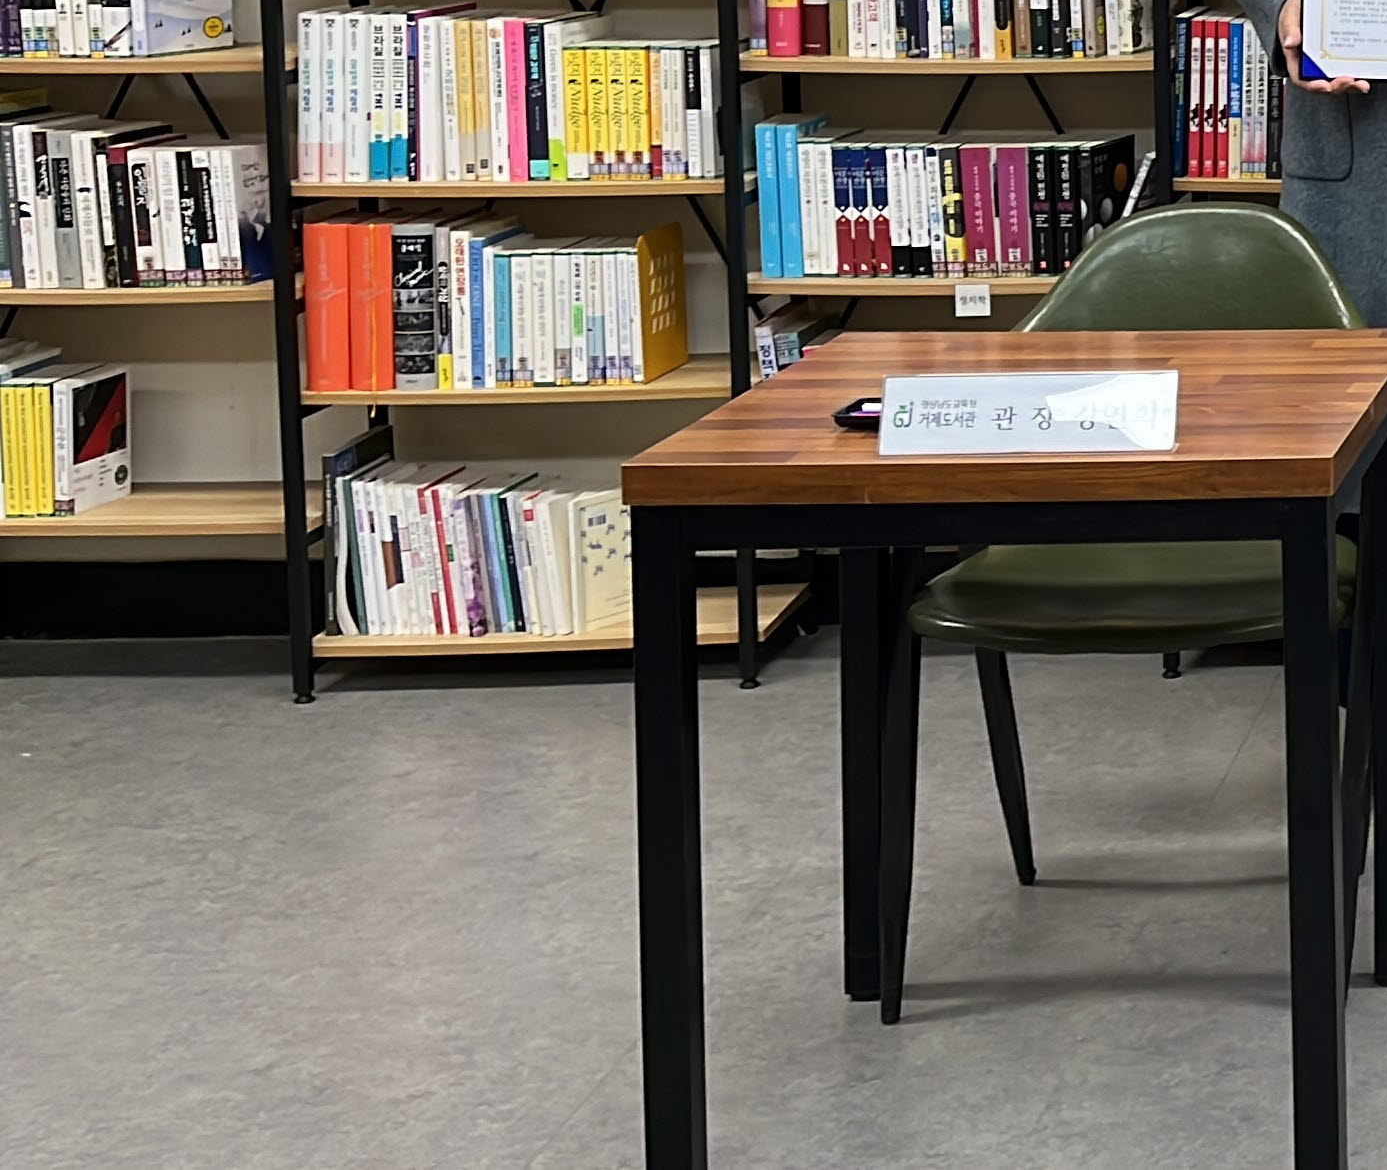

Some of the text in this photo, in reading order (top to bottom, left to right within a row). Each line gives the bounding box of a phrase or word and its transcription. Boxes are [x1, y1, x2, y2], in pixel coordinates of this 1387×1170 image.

[373, 25, 384, 57] 브라질
[392, 25, 403, 57] 브라질
[568, 88, 582, 128] Nudge
[590, 88, 604, 128] Nudge
[610, 88, 624, 128] Nudge
[630, 88, 644, 128] Nudge
[1035, 153, 1045, 200] 예정된 전쟁
[1059, 153, 1070, 200] 예정된 전쟁
[455, 238, 466, 297] 오래된 연장통
[959, 295, 987, 306] 정치학
[917, 410, 978, 429] 거제도서관
